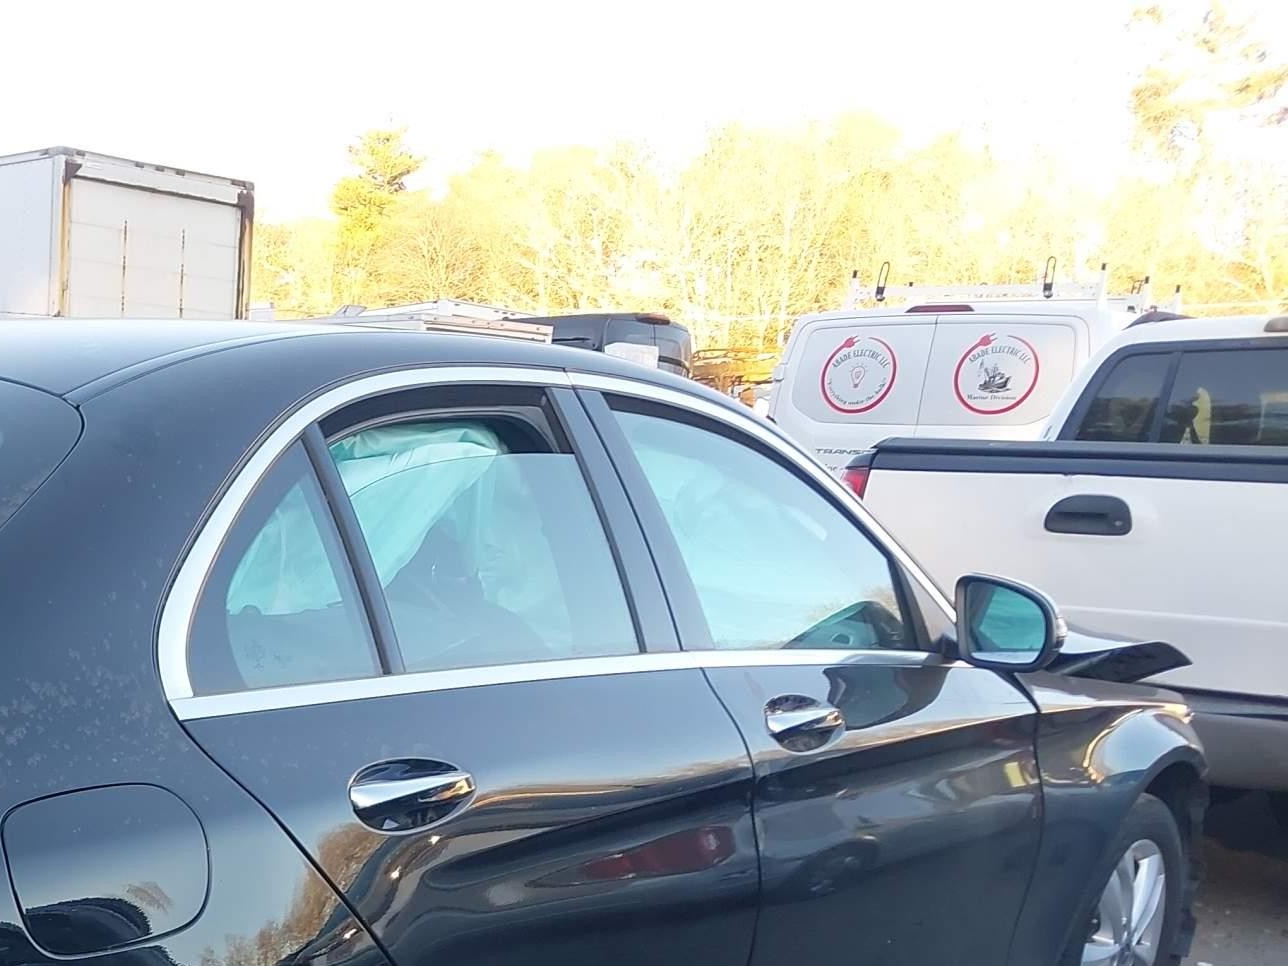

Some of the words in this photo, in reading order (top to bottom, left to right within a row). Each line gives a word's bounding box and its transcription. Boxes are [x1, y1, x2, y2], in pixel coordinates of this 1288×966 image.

[853, 348, 882, 362] ELECTRIC
[878, 356, 891, 368] LLC
[991, 345, 1021, 357] ELECTRIC
